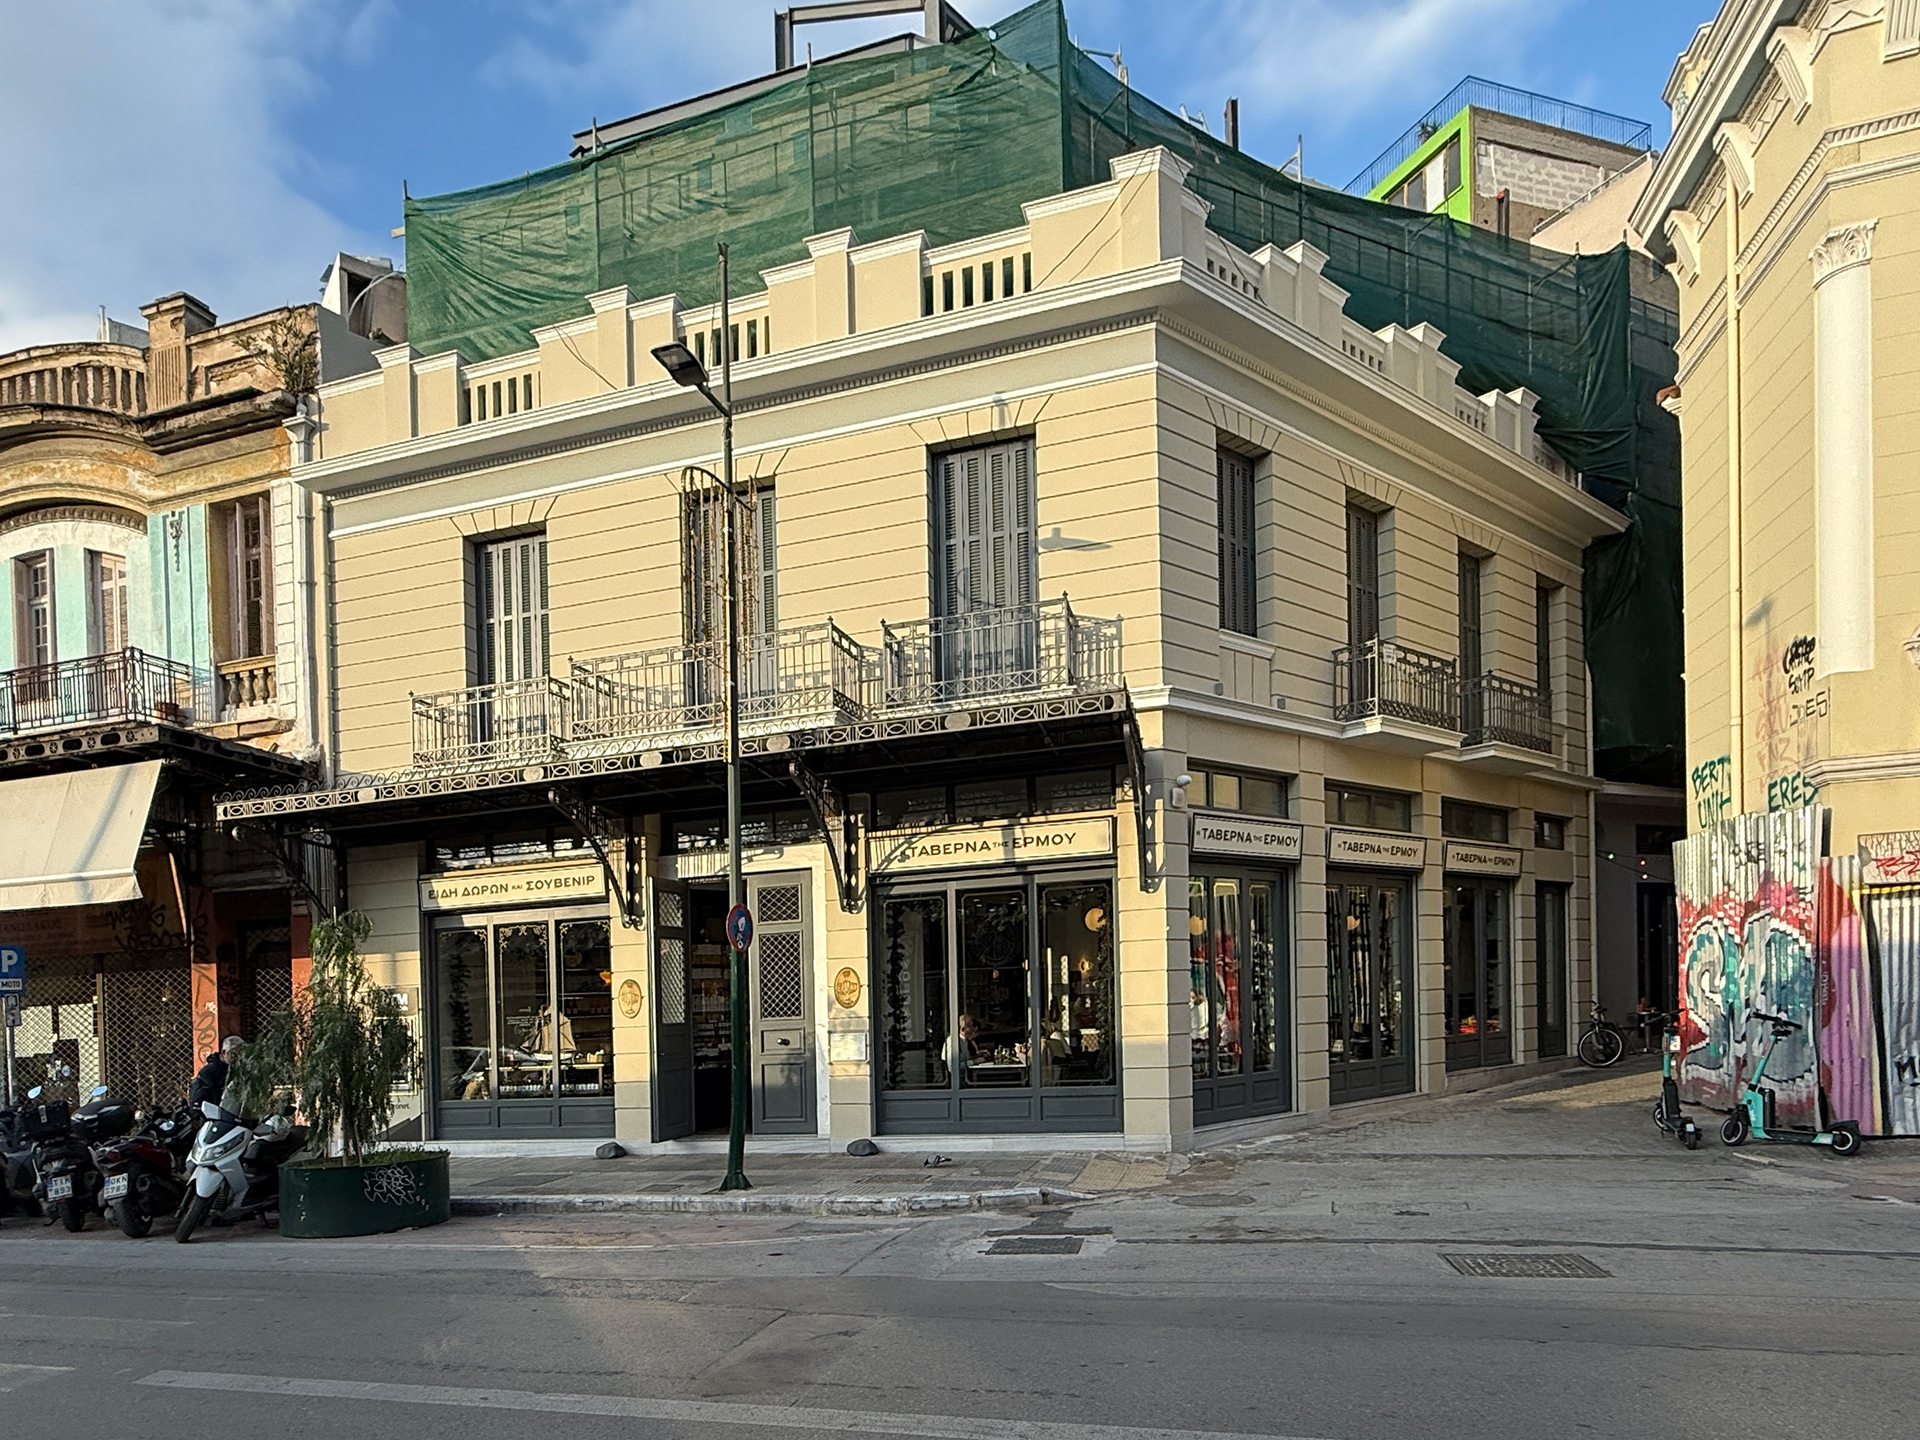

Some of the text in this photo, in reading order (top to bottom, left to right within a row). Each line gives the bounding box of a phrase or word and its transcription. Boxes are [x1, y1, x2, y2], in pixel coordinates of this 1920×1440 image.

[909, 840, 991, 857] ΤΑΒΕΡΝΑ
[992, 840, 1010, 848] ΤΗΣ
[1013, 832, 1076, 849] ΕΡΜΟΥ
[1202, 828, 1252, 844] ΤΑΒΕΡΝΑ
[1264, 834, 1298, 847] ΕΡΜΟΥ
[1342, 841, 1382, 854] ΤΑΒΕΡΝΑ
[1391, 846, 1418, 857] ΕΡΜΟΥ
[1456, 852, 1487, 863] ΤΑΒΕΡΝΑ
[1494, 856, 1516, 866] ΕΡΜΟΥ
[428, 888, 458, 899] ΕΙΔΗ
[461, 883, 509, 897] ΔΩΡΩΝ
[526, 875, 595, 891] ΣΟΥΒΕΝΙΡ
[1, 949, 18, 973] P
[1, 980, 21, 988] MOTO
